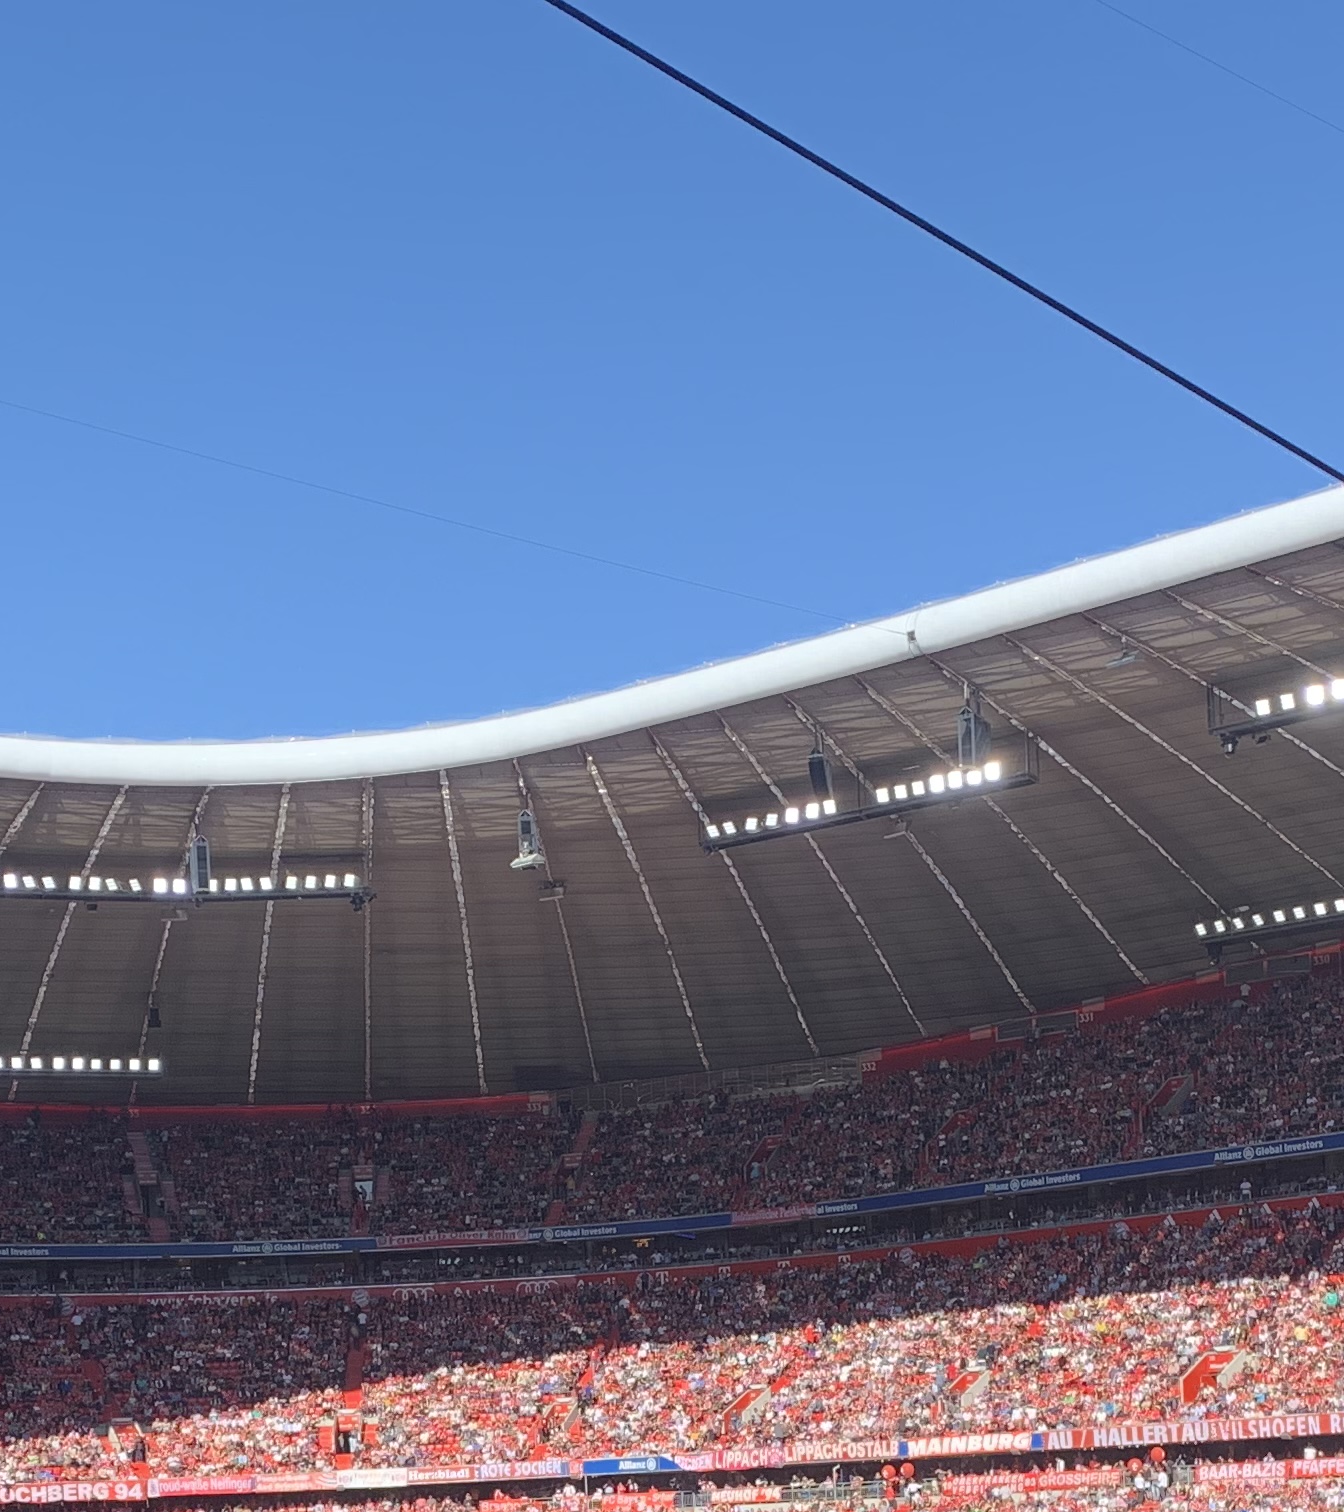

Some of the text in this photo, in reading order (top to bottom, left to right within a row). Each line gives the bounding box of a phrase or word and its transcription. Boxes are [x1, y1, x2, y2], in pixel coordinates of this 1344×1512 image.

[1214, 1140, 1324, 1161] Allianz Global Investors
[984, 1173, 1081, 1193] Allianz Global Investors
[554, 1228, 581, 1238] Global
[581, 1226, 617, 1237] Investors
[10, 1247, 49, 1256] Investors
[232, 1244, 260, 1253] Allianz
[274, 1243, 300, 1252] Global
[1047, 1430, 1072, 1449] AU
[1093, 1422, 1209, 1447] HALLERTAU
[1220, 1416, 1321, 1440] VILSHOFEN
[907, 1433, 1031, 1456] MAINBURG
[618, 1461, 646, 1470] Allianz
[715, 1448, 768, 1468] LIPPACH
[480, 1462, 512, 1479] ROTE
[513, 1460, 562, 1477] SOCKEN
